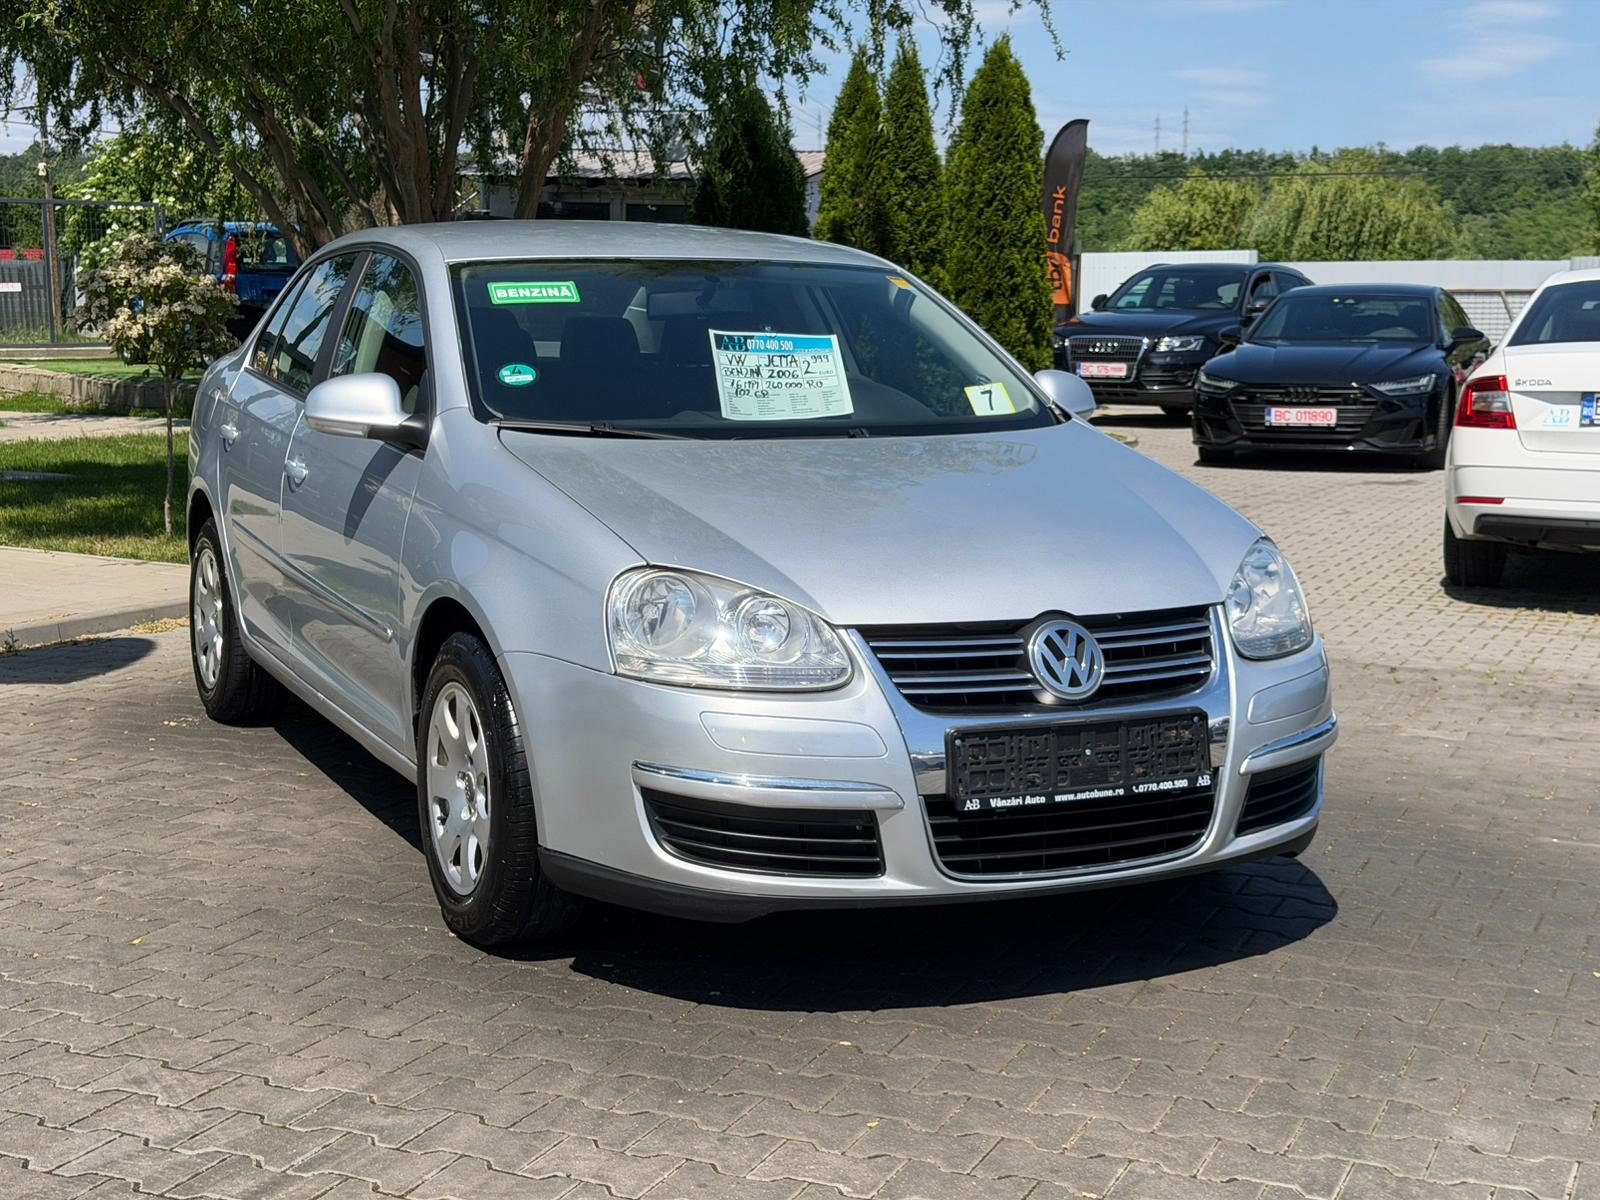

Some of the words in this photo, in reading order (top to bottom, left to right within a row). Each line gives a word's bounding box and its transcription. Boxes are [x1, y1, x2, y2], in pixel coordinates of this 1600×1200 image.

[1047, 185, 1067, 245] bank
[495, 286, 572, 298] BENZINĂ
[746, 338, 765, 350] 0770
[766, 339, 779, 350] 400
[780, 340, 794, 351] 500
[726, 354, 747, 367] VW
[764, 354, 799, 367] JETTA
[767, 369, 799, 379] 2006
[765, 381, 783, 390] 260
[980, 389, 994, 411] 7
[1274, 410, 1290, 422] BC
[1295, 410, 1333, 422] 011890
[1025, 795, 1046, 805] Auto
[1054, 788, 1124, 802] www.autobune.ro
[1138, 779, 1189, 793] 0770.400.500
